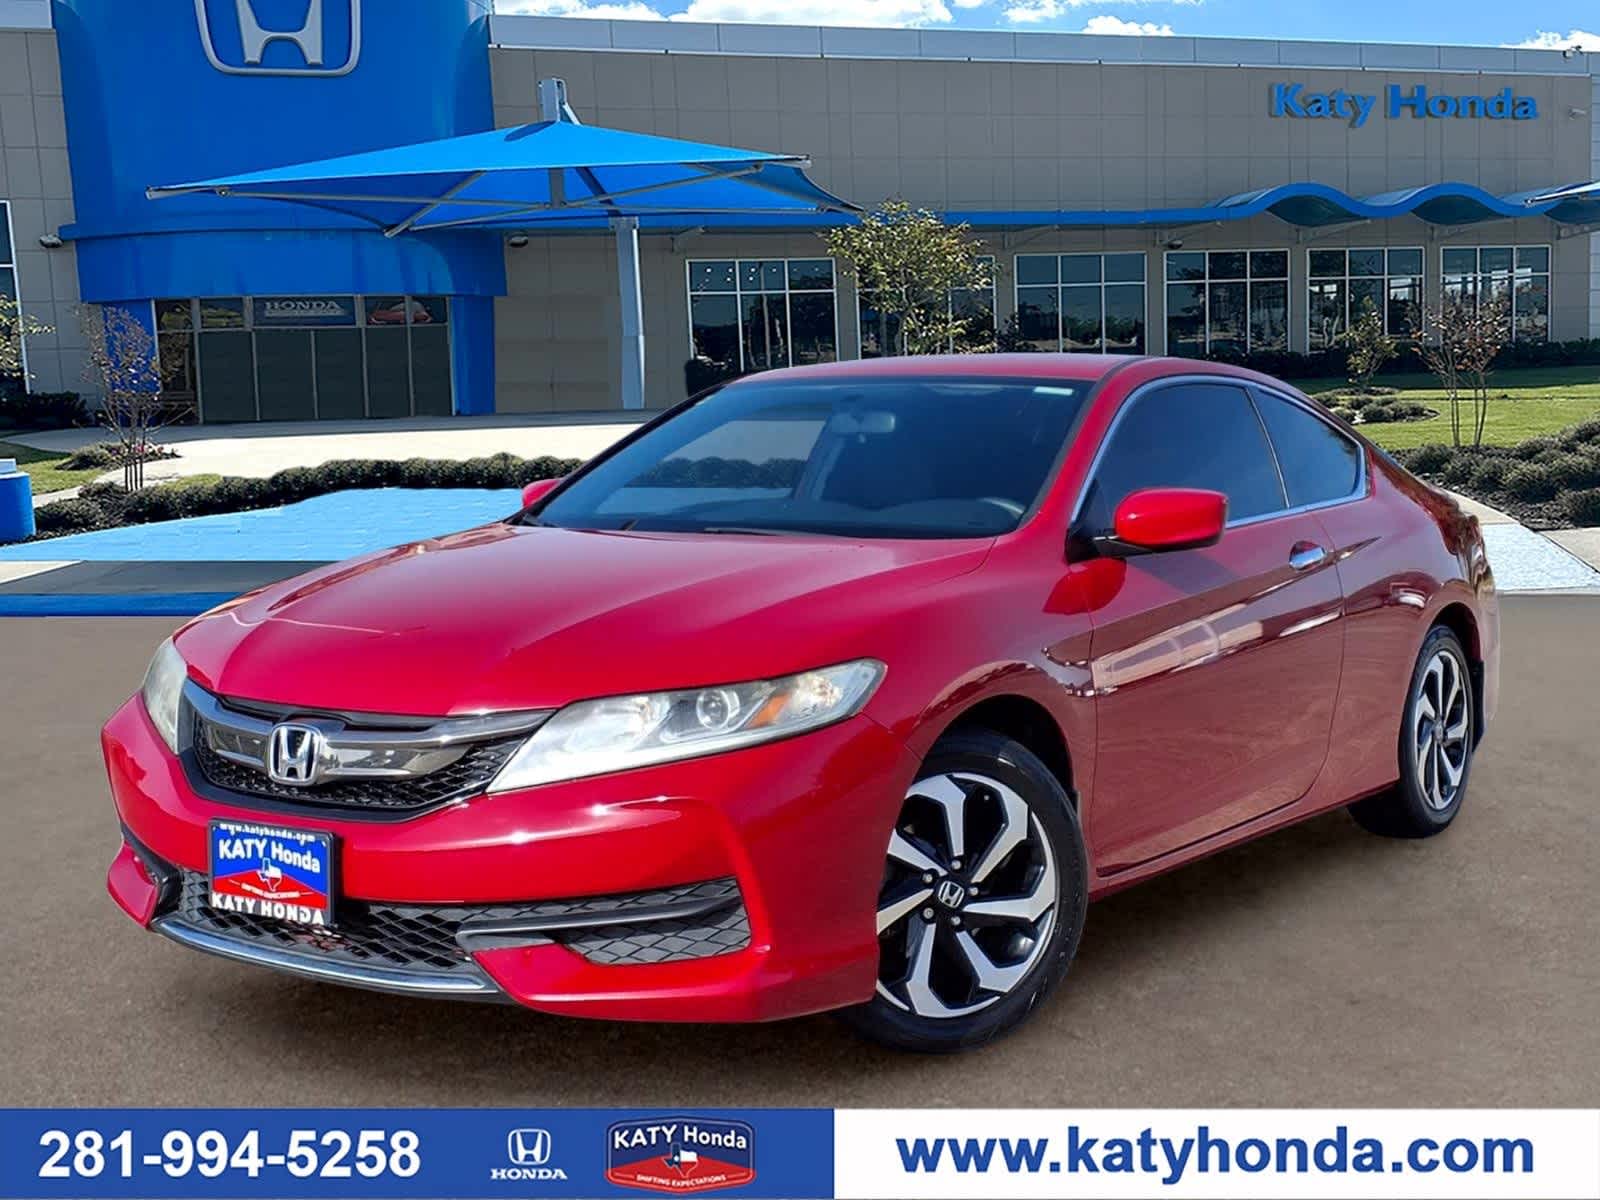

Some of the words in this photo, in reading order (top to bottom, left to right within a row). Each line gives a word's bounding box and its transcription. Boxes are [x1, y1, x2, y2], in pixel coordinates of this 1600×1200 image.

[1270, 83, 1376, 128] Katy
[1385, 84, 1539, 120] Honda
[265, 300, 344, 311] HONDA
[219, 838, 267, 859] KATY
[271, 840, 320, 873] Honda
[211, 891, 255, 914] KATY
[260, 899, 325, 925] HONDA
